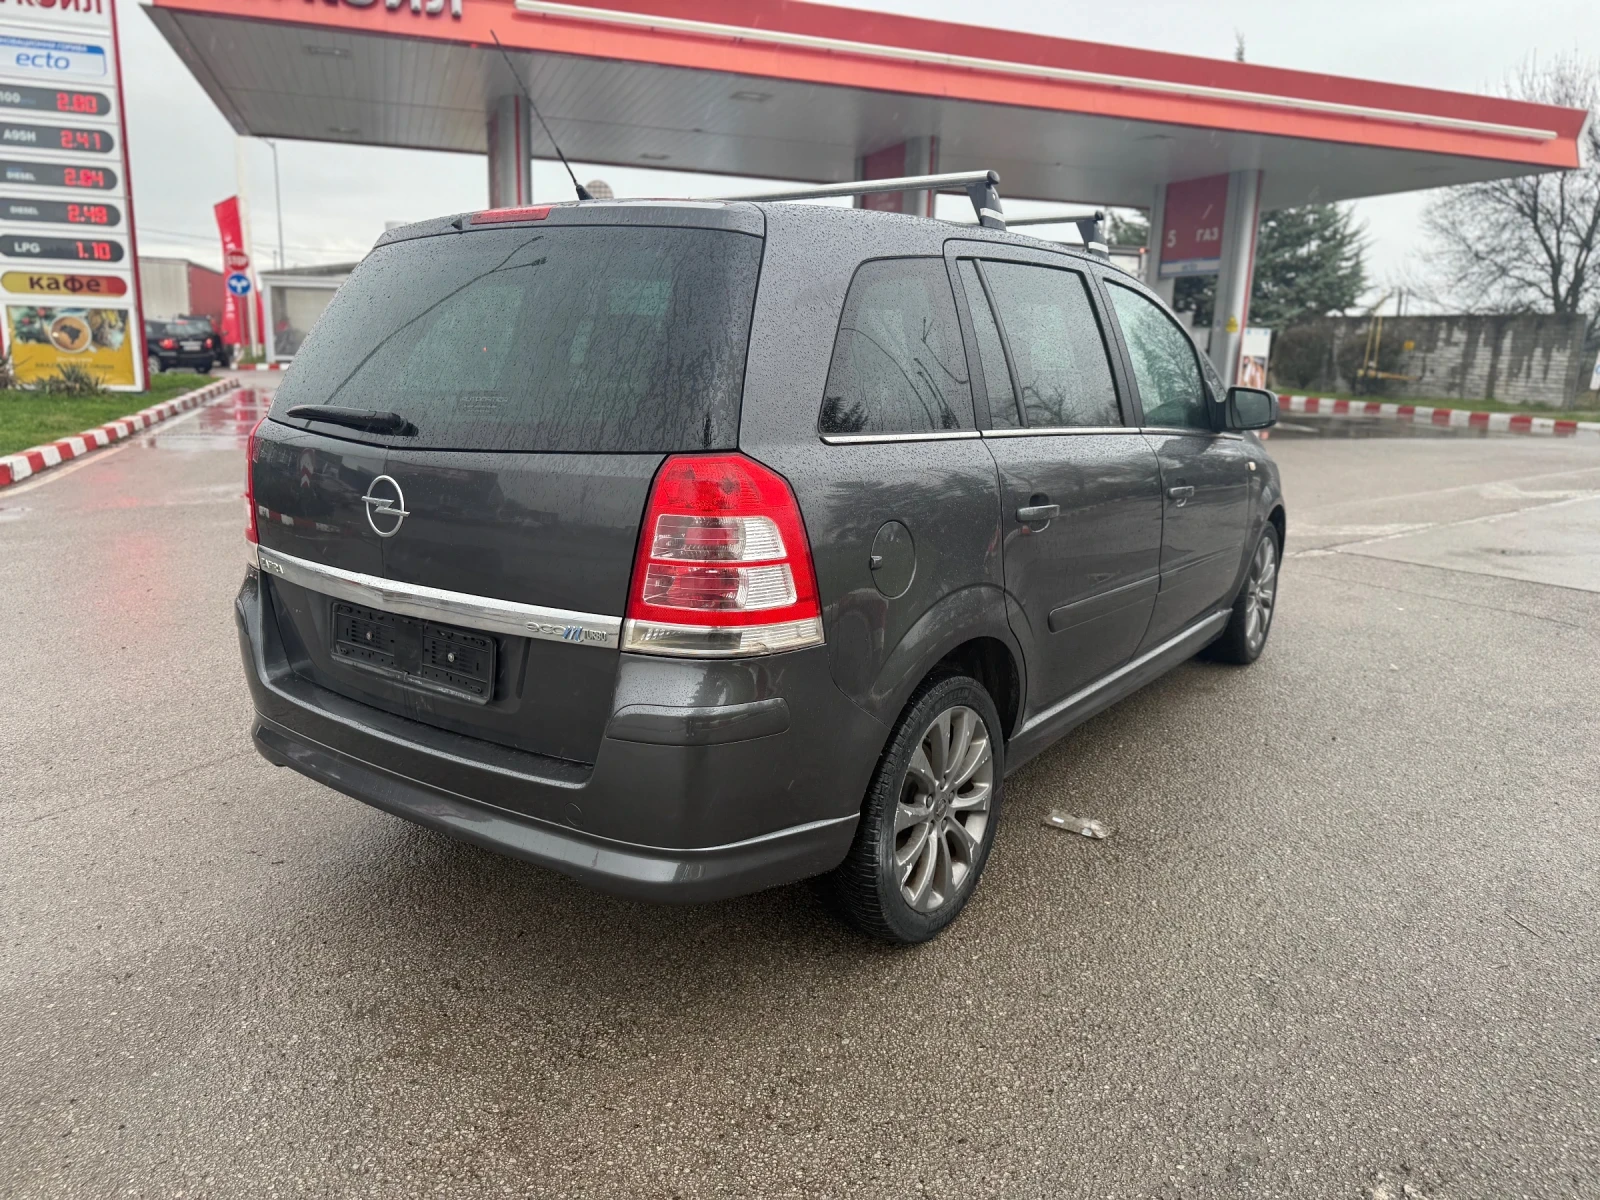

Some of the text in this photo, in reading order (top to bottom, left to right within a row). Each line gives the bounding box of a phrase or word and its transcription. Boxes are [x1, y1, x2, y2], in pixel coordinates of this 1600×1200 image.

[15, 51, 70, 70] ecto
[60, 129, 102, 150] 2.41
[1167, 227, 1218, 248] 5 ГАЗ
[14, 241, 112, 261] LPG 1.10
[28, 275, 101, 293] кафе
